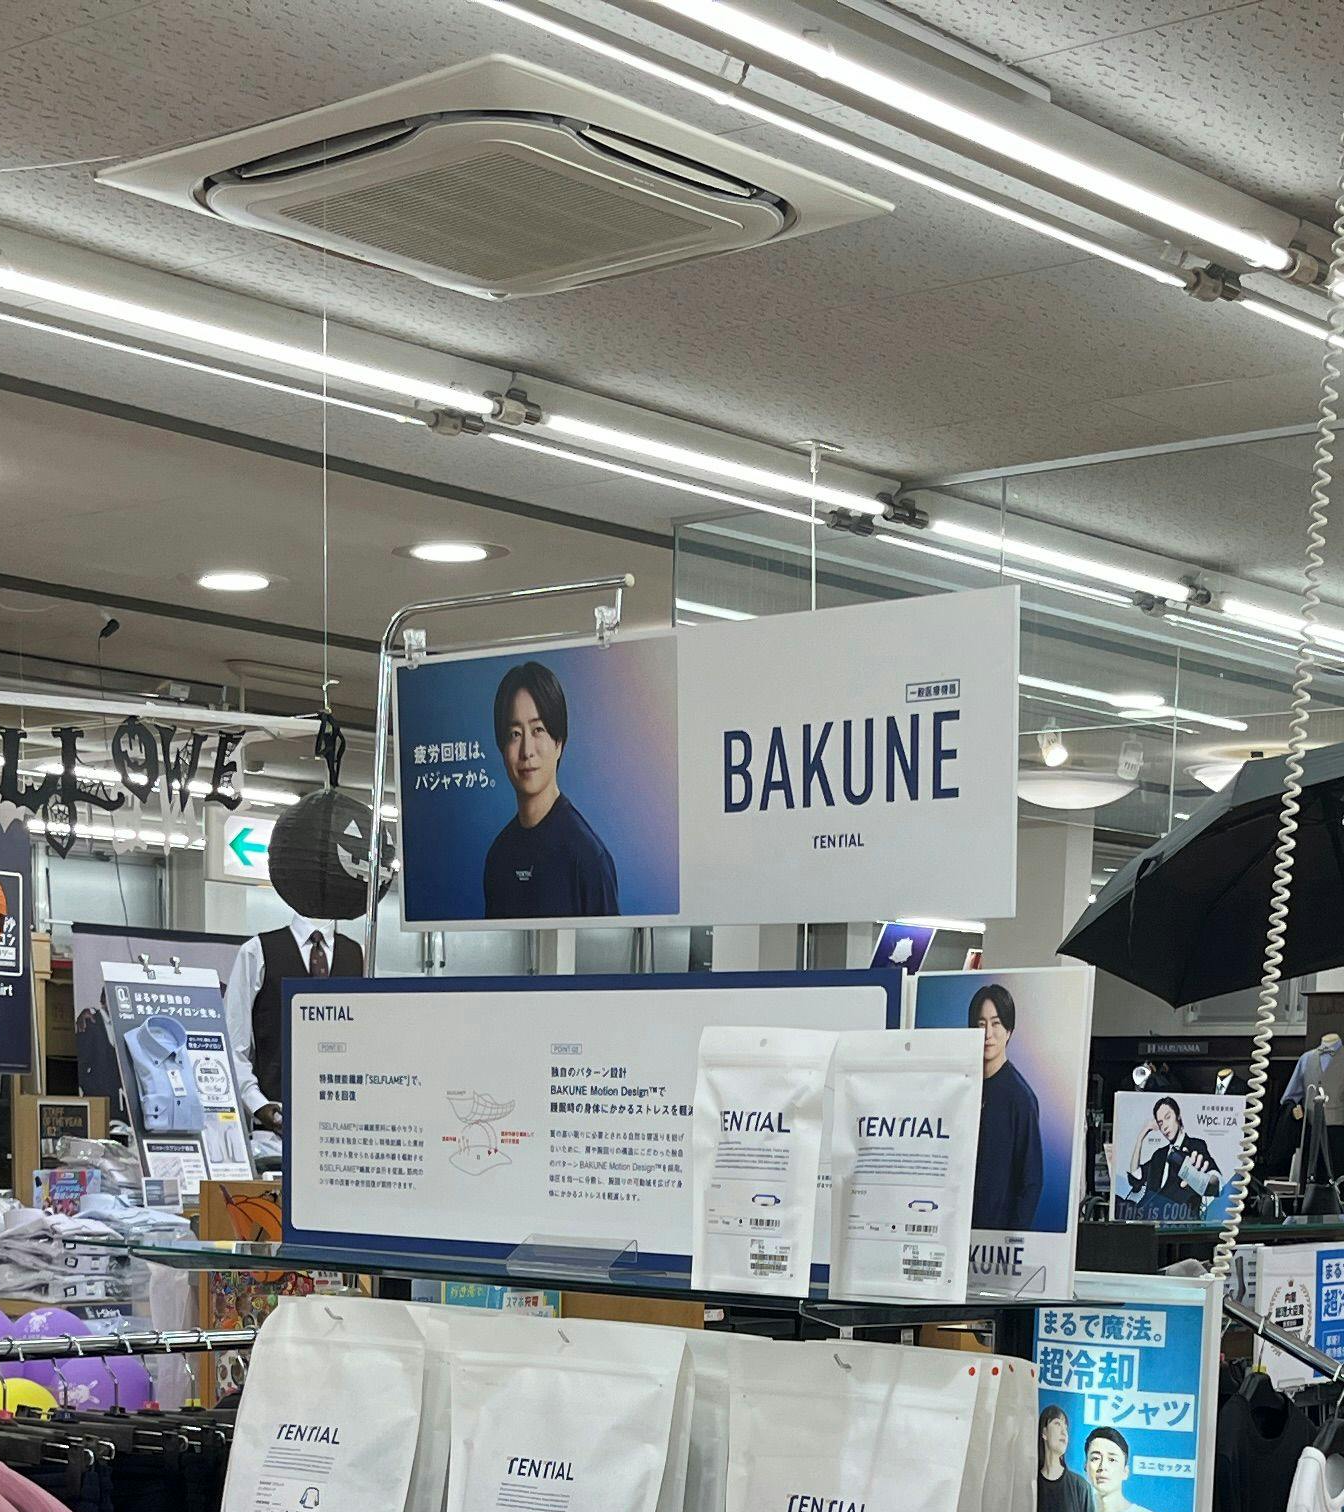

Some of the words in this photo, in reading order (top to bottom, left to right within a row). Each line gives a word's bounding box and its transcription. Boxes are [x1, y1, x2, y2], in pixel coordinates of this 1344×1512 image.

[413, 741, 487, 765] 疲労回復は、
[723, 710, 961, 813] BAKUNE
[414, 768, 496, 791] パジャマから。
[813, 832, 865, 850] TENTIAL
[299, 1005, 355, 1022] TENTIAL
[551, 1067, 627, 1079] 独自のパターン設計
[550, 1085, 588, 1096] BAKUNE
[590, 1086, 619, 1096] Motion
[1043, 1310, 1162, 1342] まるで魔法。
[1038, 1346, 1135, 1391] 超冷却
[1087, 1394, 1191, 1427] Tシャツ
[274, 1423, 341, 1445] TENTIAL
[506, 1456, 575, 1482] TENTIAL
